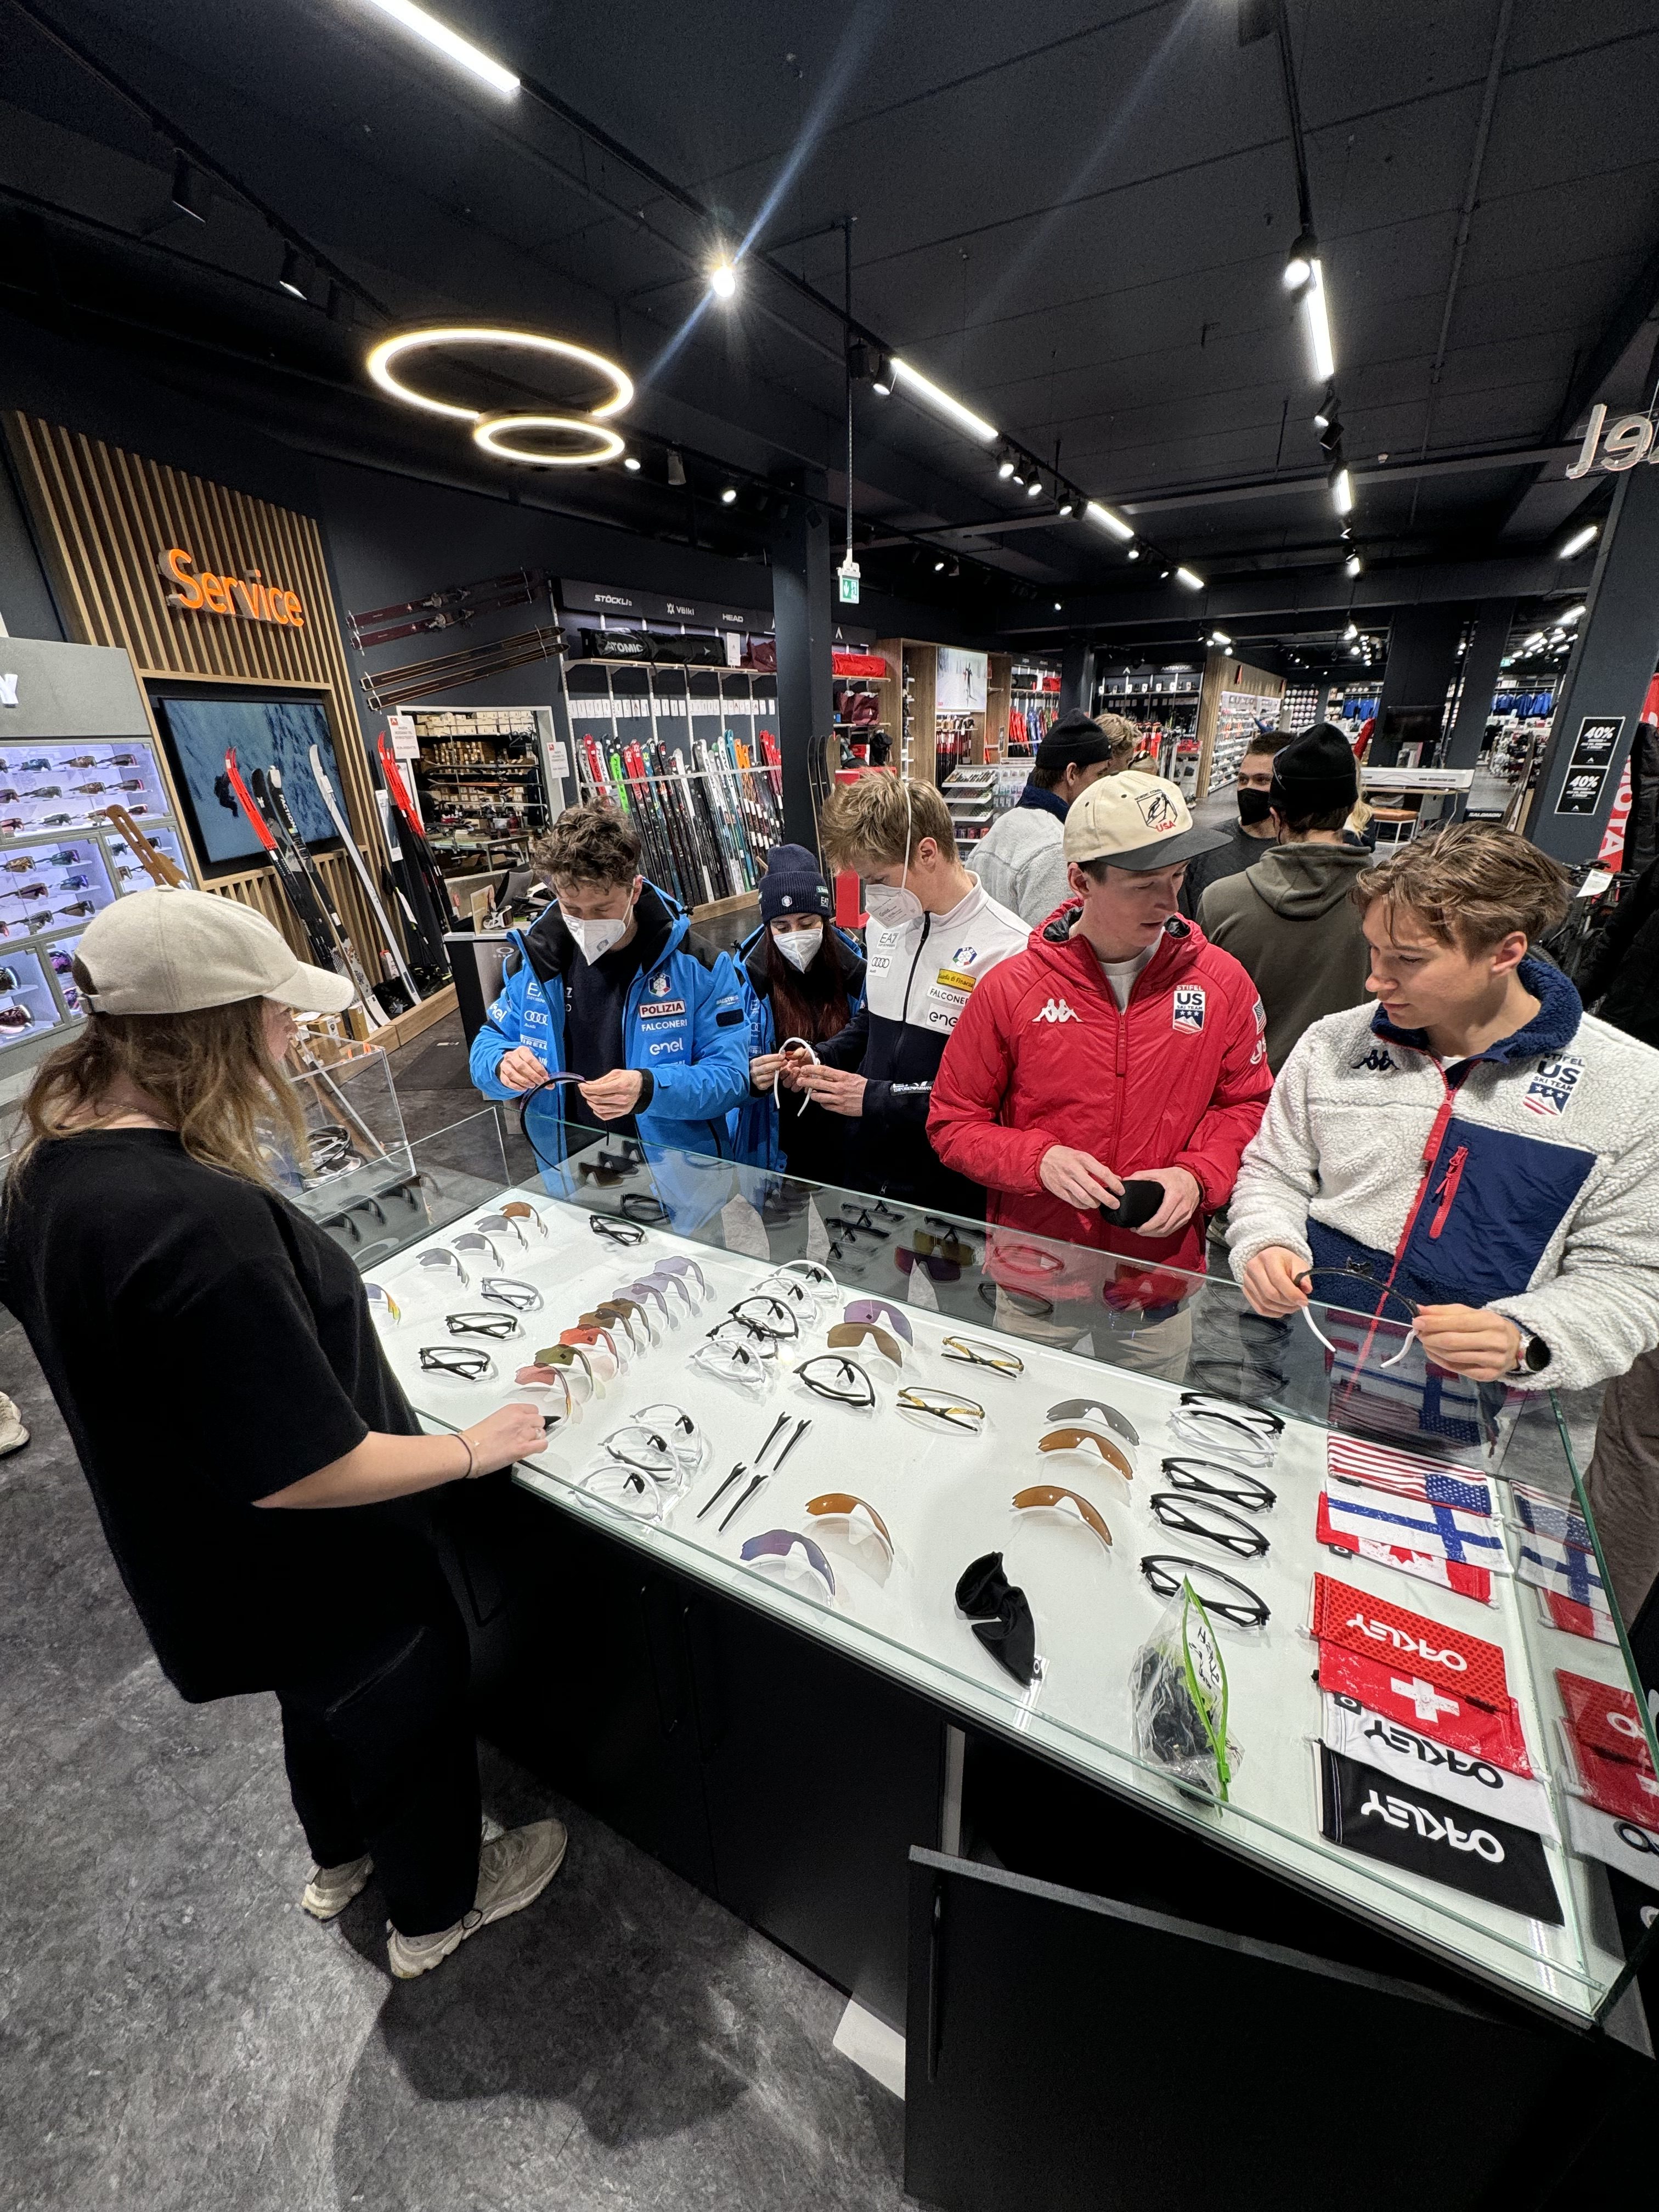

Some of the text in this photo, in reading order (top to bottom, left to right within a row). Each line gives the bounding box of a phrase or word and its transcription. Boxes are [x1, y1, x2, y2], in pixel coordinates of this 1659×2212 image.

[168, 549, 304, 627] Service
[676, 606, 695, 615] Völkl
[722, 613, 743, 623] HEAD
[604, 641, 644, 653] ATOMIC
[1583, 727, 1616, 739] 40%
[1568, 775, 1600, 788] 40%
[279, 794, 297, 828] FACTION
[1155, 820, 1176, 832] USA
[879, 933, 899, 944] EA7
[1177, 992, 1203, 1006] US
[641, 1002, 683, 1015] POLIZIA
[641, 1019, 687, 1032] FALCONERI
[929, 1012, 958, 1027] ene
[649, 1037, 684, 1056] enel
[1537, 1059, 1581, 1085] US
[1533, 1076, 1573, 1092] SKI TEAM
[1346, 1613, 1468, 1672] OAKLEY
[1364, 1720, 1504, 1789] OAKLEY
[1361, 1789, 1505, 1863] OAKLEY
